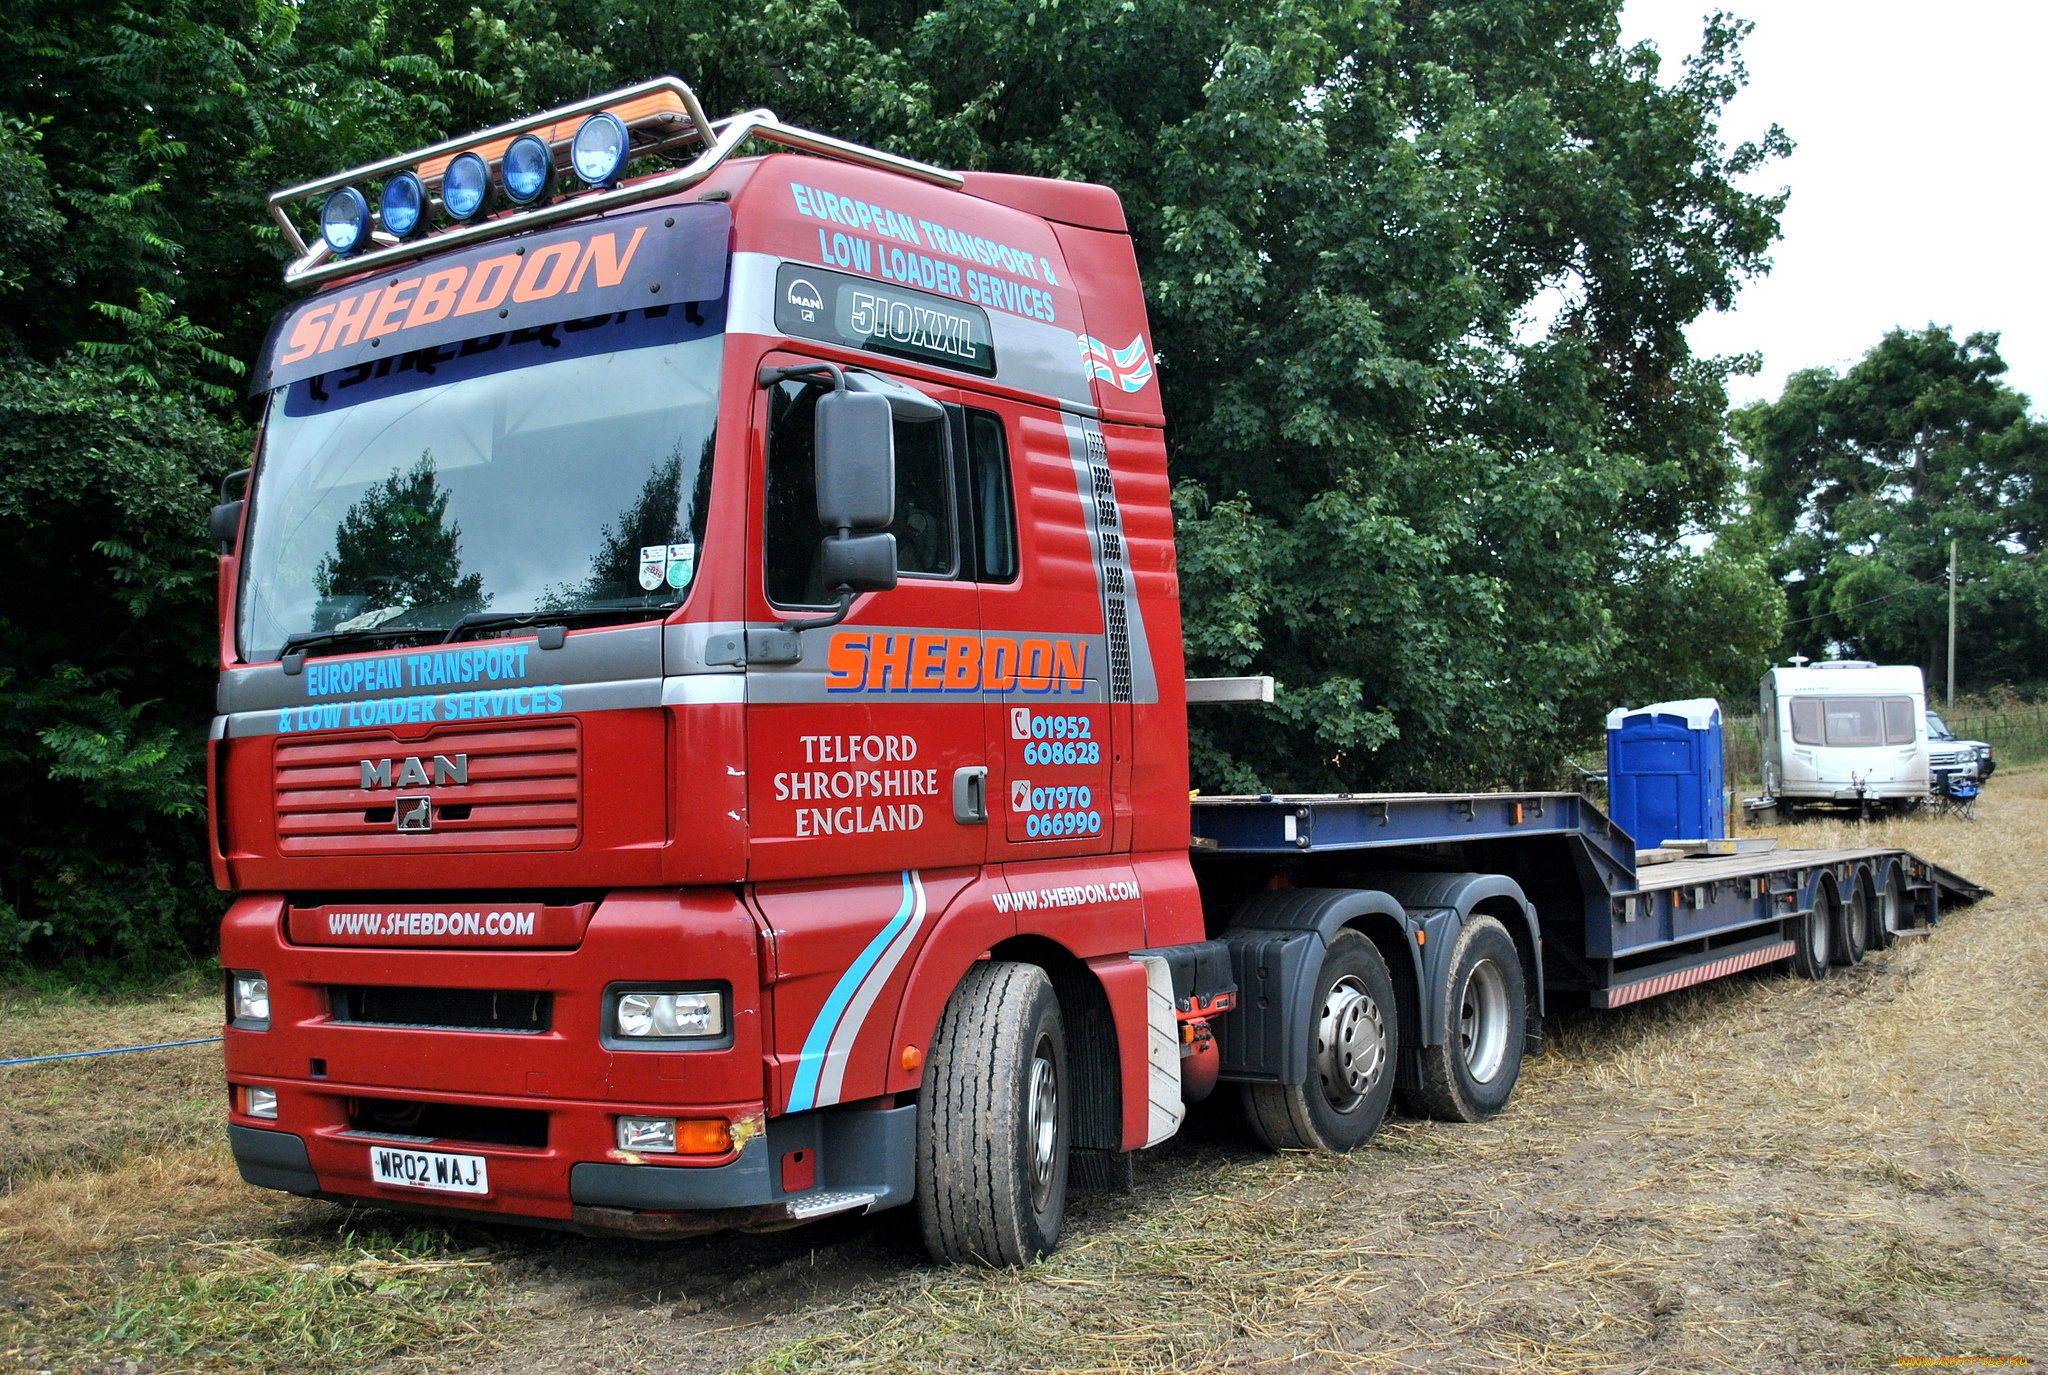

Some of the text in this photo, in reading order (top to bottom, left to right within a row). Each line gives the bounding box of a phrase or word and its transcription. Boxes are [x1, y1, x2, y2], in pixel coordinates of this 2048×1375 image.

[790, 182, 1060, 286] EUROPEAN TRANSPORT &
[818, 229, 1056, 322] LOW LOADER SERVICES
[281, 227, 648, 365] SHEBDON
[790, 295, 821, 310] MAN
[307, 646, 529, 696] EUROPEAN TRANSPORT
[825, 632, 1089, 694] SHEBDON
[278, 684, 563, 733] & LOW LOADER SERVICES
[1031, 716, 1091, 740] 01952
[800, 735, 918, 763] TELFORD
[1024, 741, 1100, 766] 608628
[360, 753, 469, 789] MAN
[773, 769, 939, 801] SHROPSHIRE
[1031, 786, 1092, 811] 07970
[795, 804, 924, 837] ENGLAND
[1026, 810, 1101, 838] 066990
[991, 880, 1141, 914] WWW.SHEBDON.COM
[328, 912, 535, 936] WWW.SHEBDON.COM
[379, 1151, 478, 1186] WR02 WAJ
